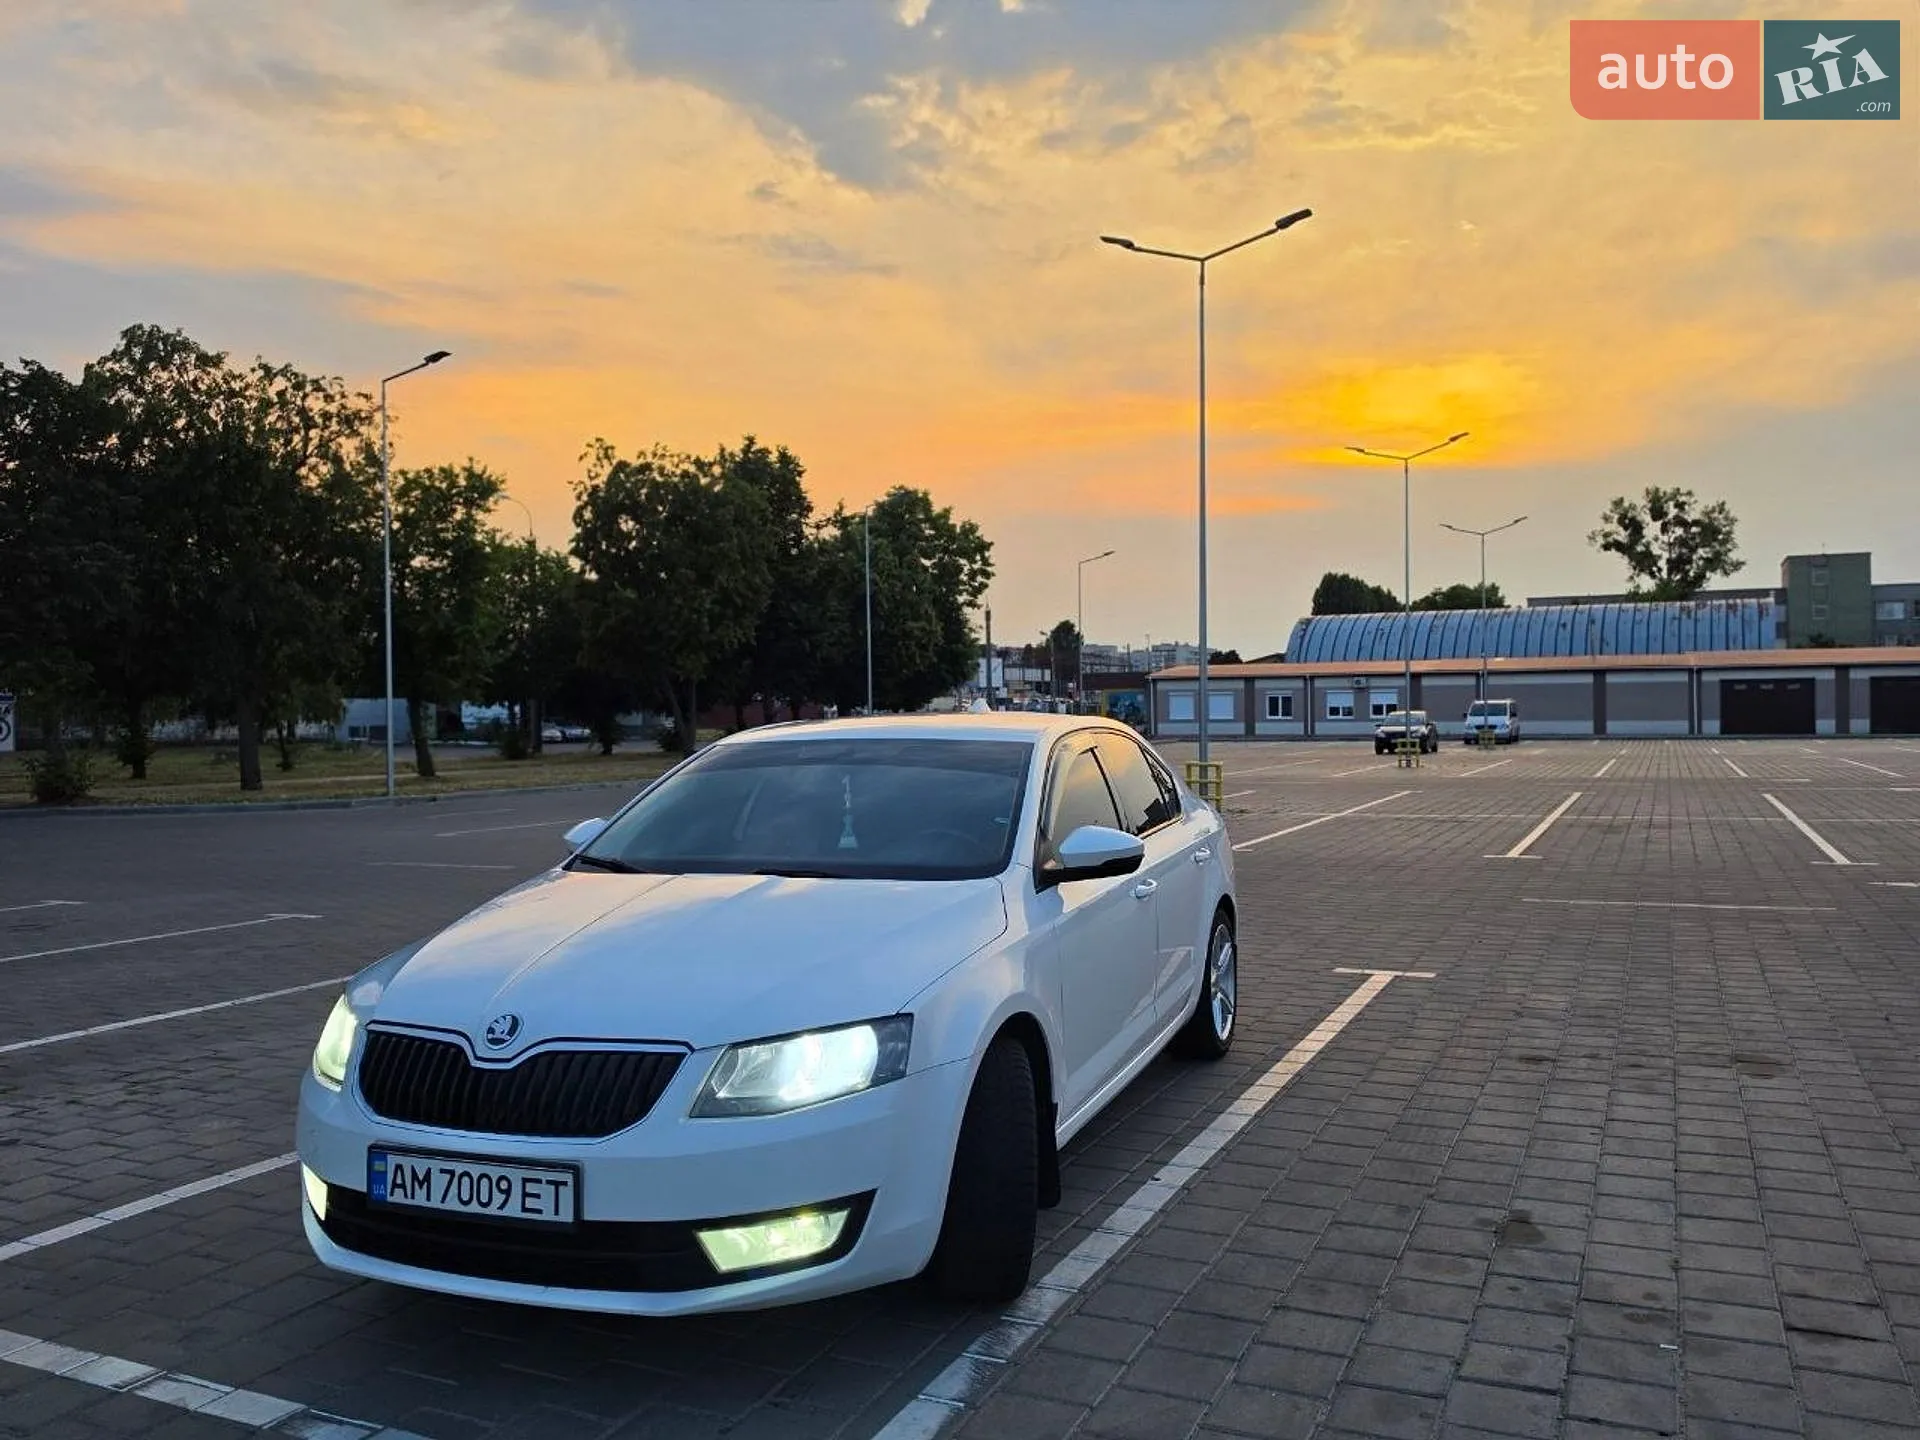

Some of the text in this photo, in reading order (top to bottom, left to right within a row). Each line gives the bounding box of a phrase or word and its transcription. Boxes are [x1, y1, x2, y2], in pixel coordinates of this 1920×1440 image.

[373, 1183, 386, 1196] UA
[389, 1163, 568, 1216] AM 7009 ET
